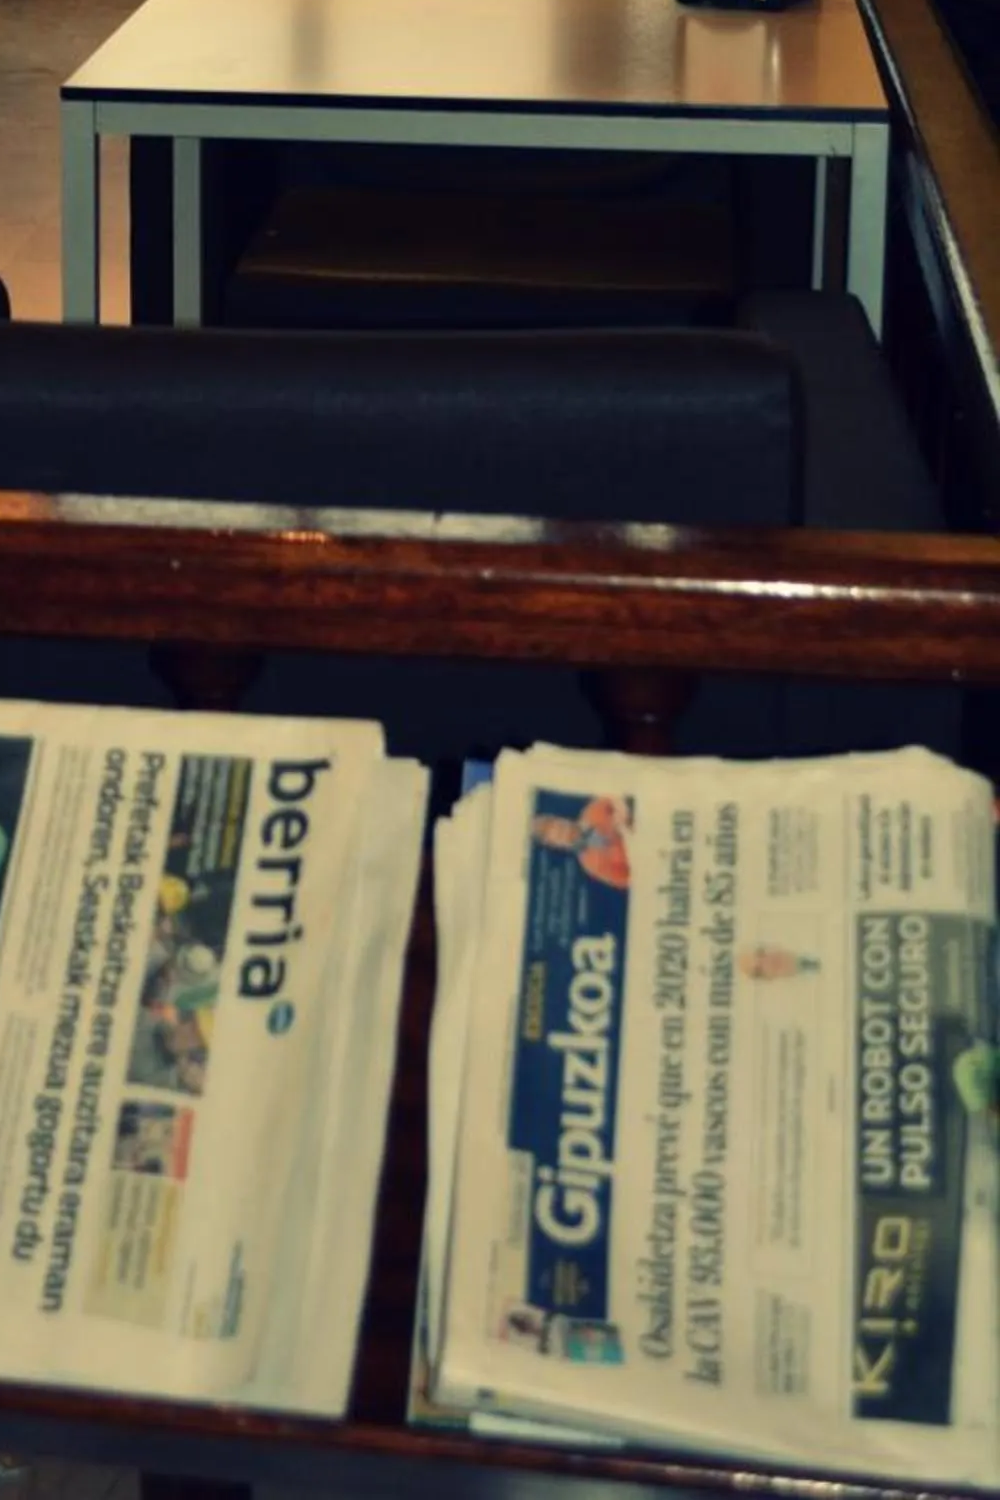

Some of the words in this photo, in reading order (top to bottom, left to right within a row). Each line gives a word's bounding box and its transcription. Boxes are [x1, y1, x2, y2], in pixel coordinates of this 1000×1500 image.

[83, 746, 127, 868] ondoren,
[122, 751, 166, 866] Prefetak
[672, 809, 694, 842] en
[705, 803, 738, 867] años
[237, 757, 331, 998] berria
[655, 846, 694, 927] habrá
[67, 872, 111, 986] Seaskak
[701, 911, 735, 945] de
[863, 918, 893, 991] CON
[653, 931, 688, 1011] 2020
[700, 948, 734, 1008] más
[898, 914, 929, 1057] SEGURO
[44, 991, 82, 1091] mezua
[86, 1011, 114, 1057] ere
[661, 1014, 685, 1049] en
[706, 1014, 731, 1065] con
[863, 996, 894, 1122] ROBOT
[535, 932, 616, 1244] Gipuzkoa
[657, 1054, 692, 1108] que
[703, 1070, 729, 1164] vascos
[18, 1093, 63, 1215] gogortu
[63, 1060, 104, 1186] auzitara
[643, 1112, 688, 1198] prevé
[863, 1128, 894, 1184] UN
[899, 1062, 931, 1189] PULSO
[11, 1218, 44, 1262] du
[40, 1190, 82, 1313] eraman
[635, 1202, 678, 1359] Osakidetza
[685, 1298, 721, 1354] CAV
[682, 1359, 721, 1384] la
